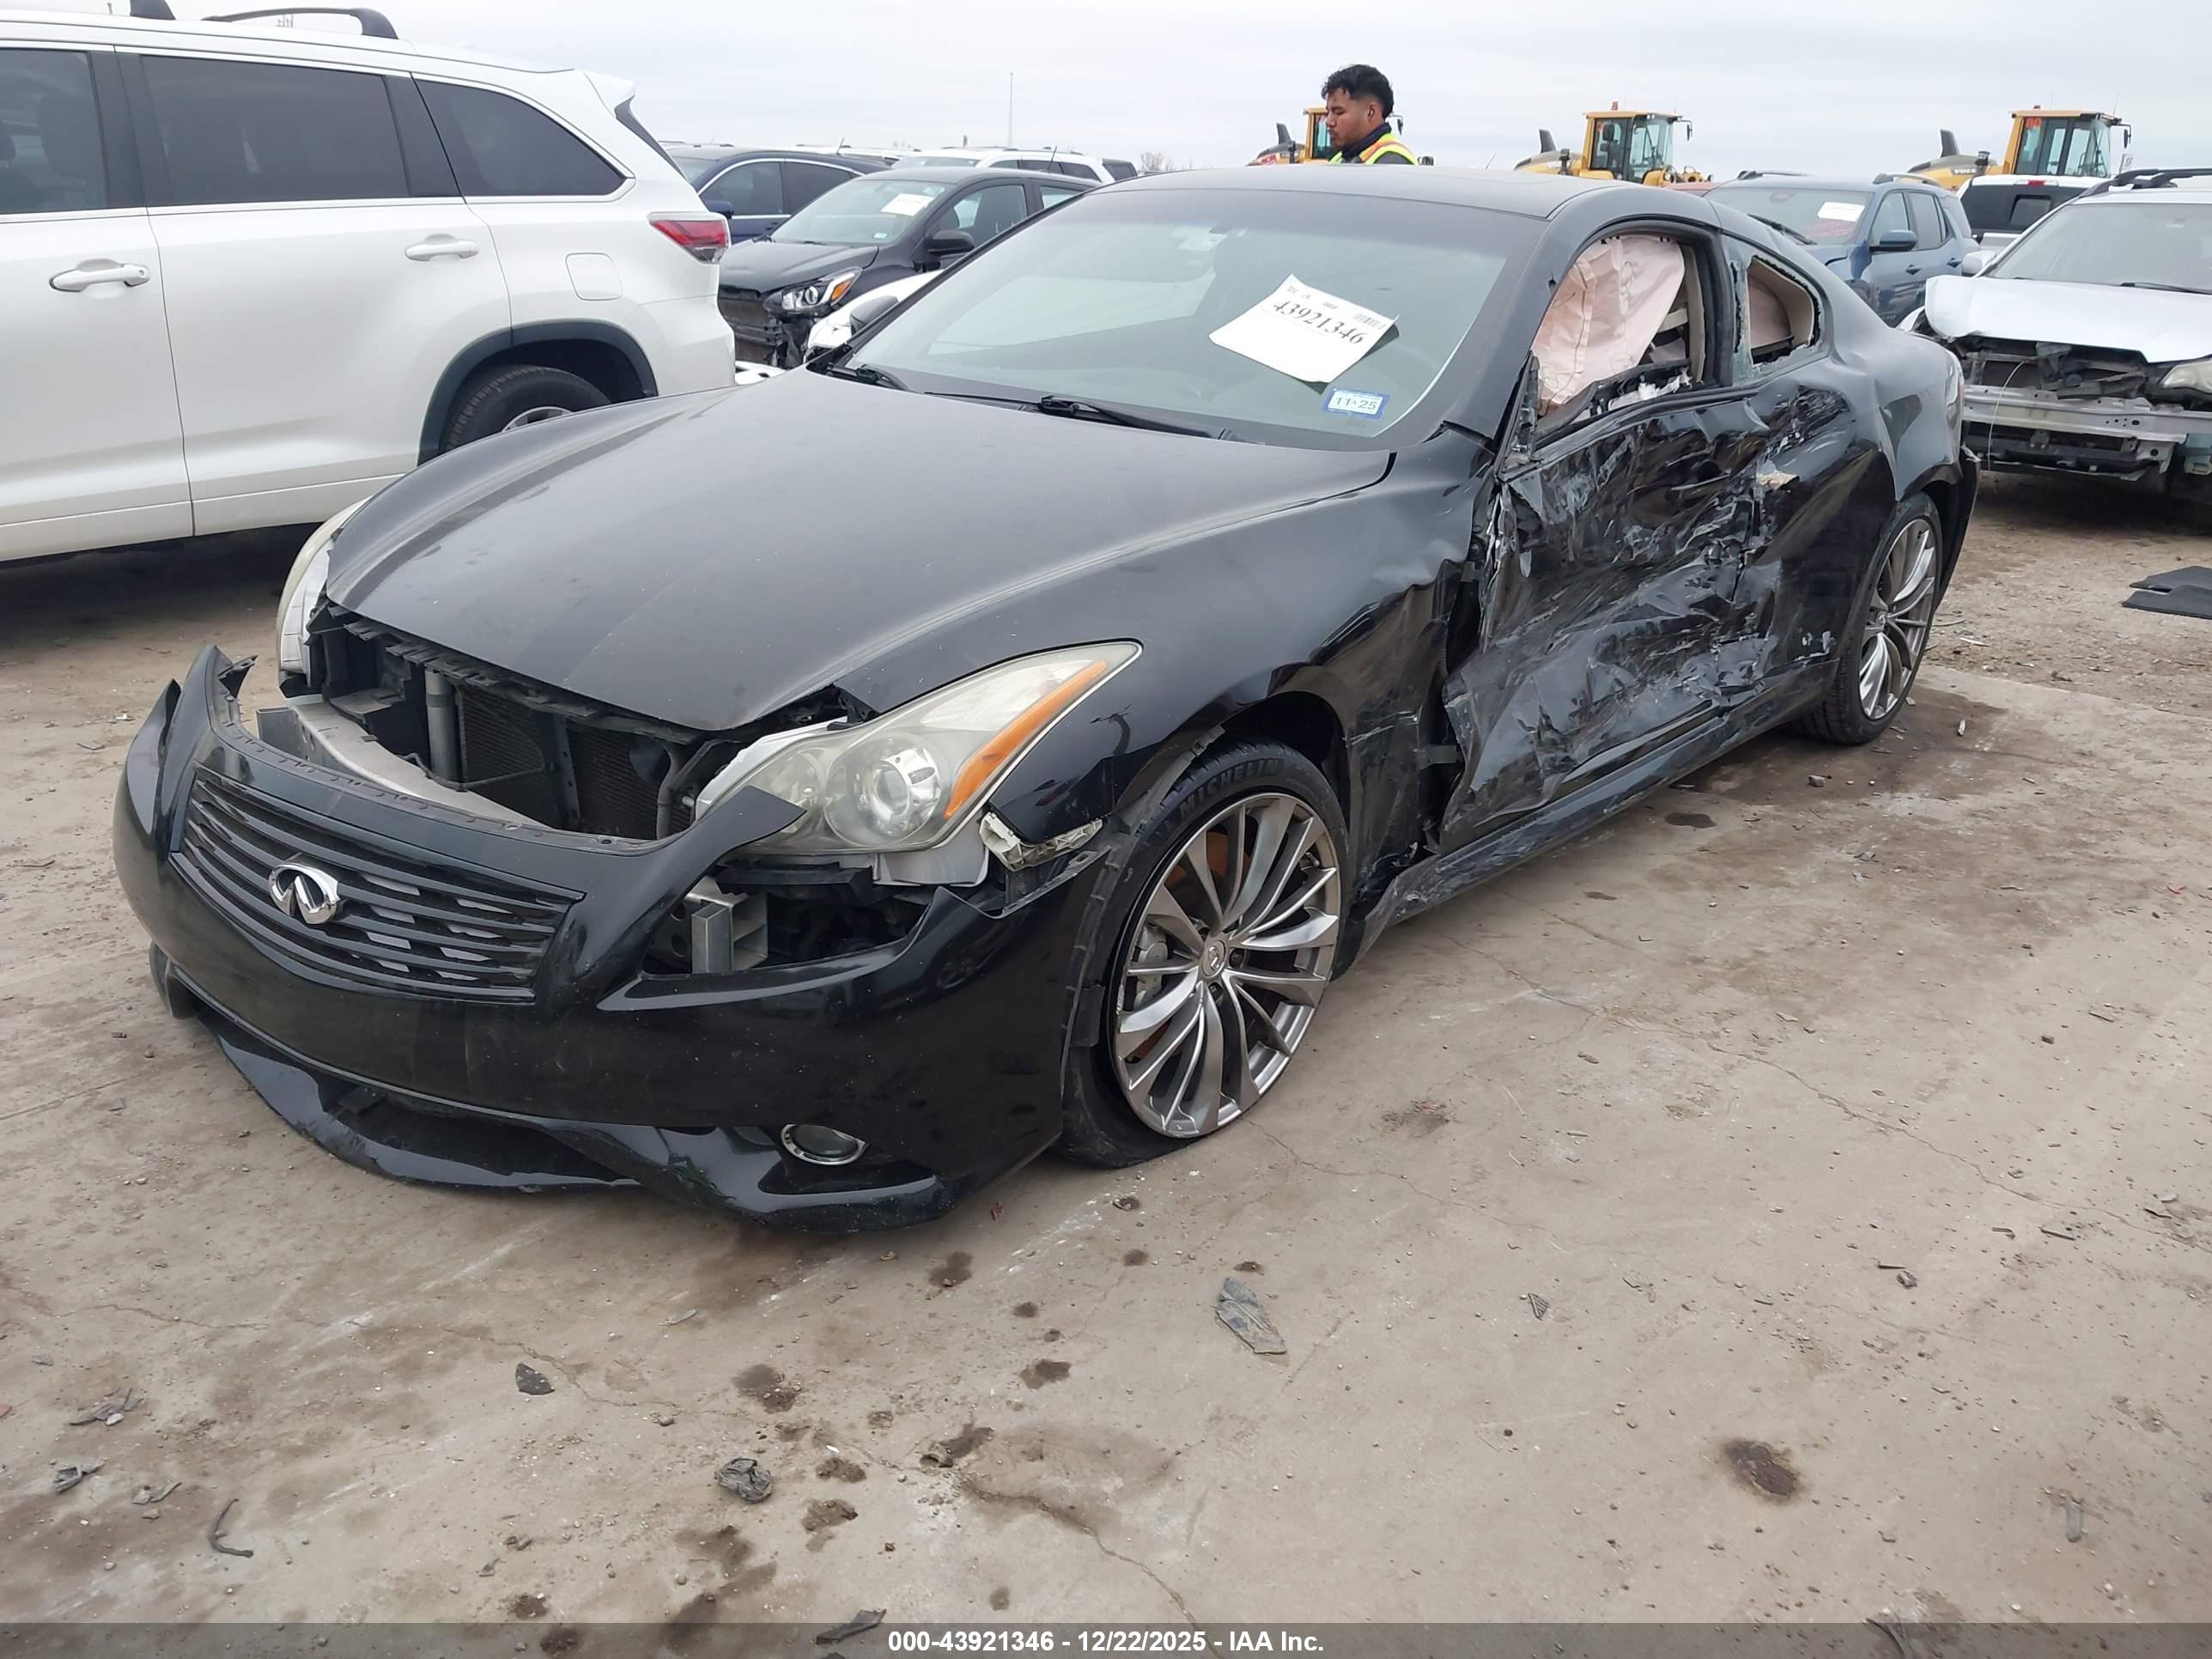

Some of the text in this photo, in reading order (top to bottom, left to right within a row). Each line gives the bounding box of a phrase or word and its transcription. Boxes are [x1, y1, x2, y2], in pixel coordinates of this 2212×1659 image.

[1273, 301, 1368, 344] 43921346
[1336, 397, 1351, 406] 11
[1358, 399, 1377, 410] 25
[1179, 757, 1285, 821] MICHELIN
